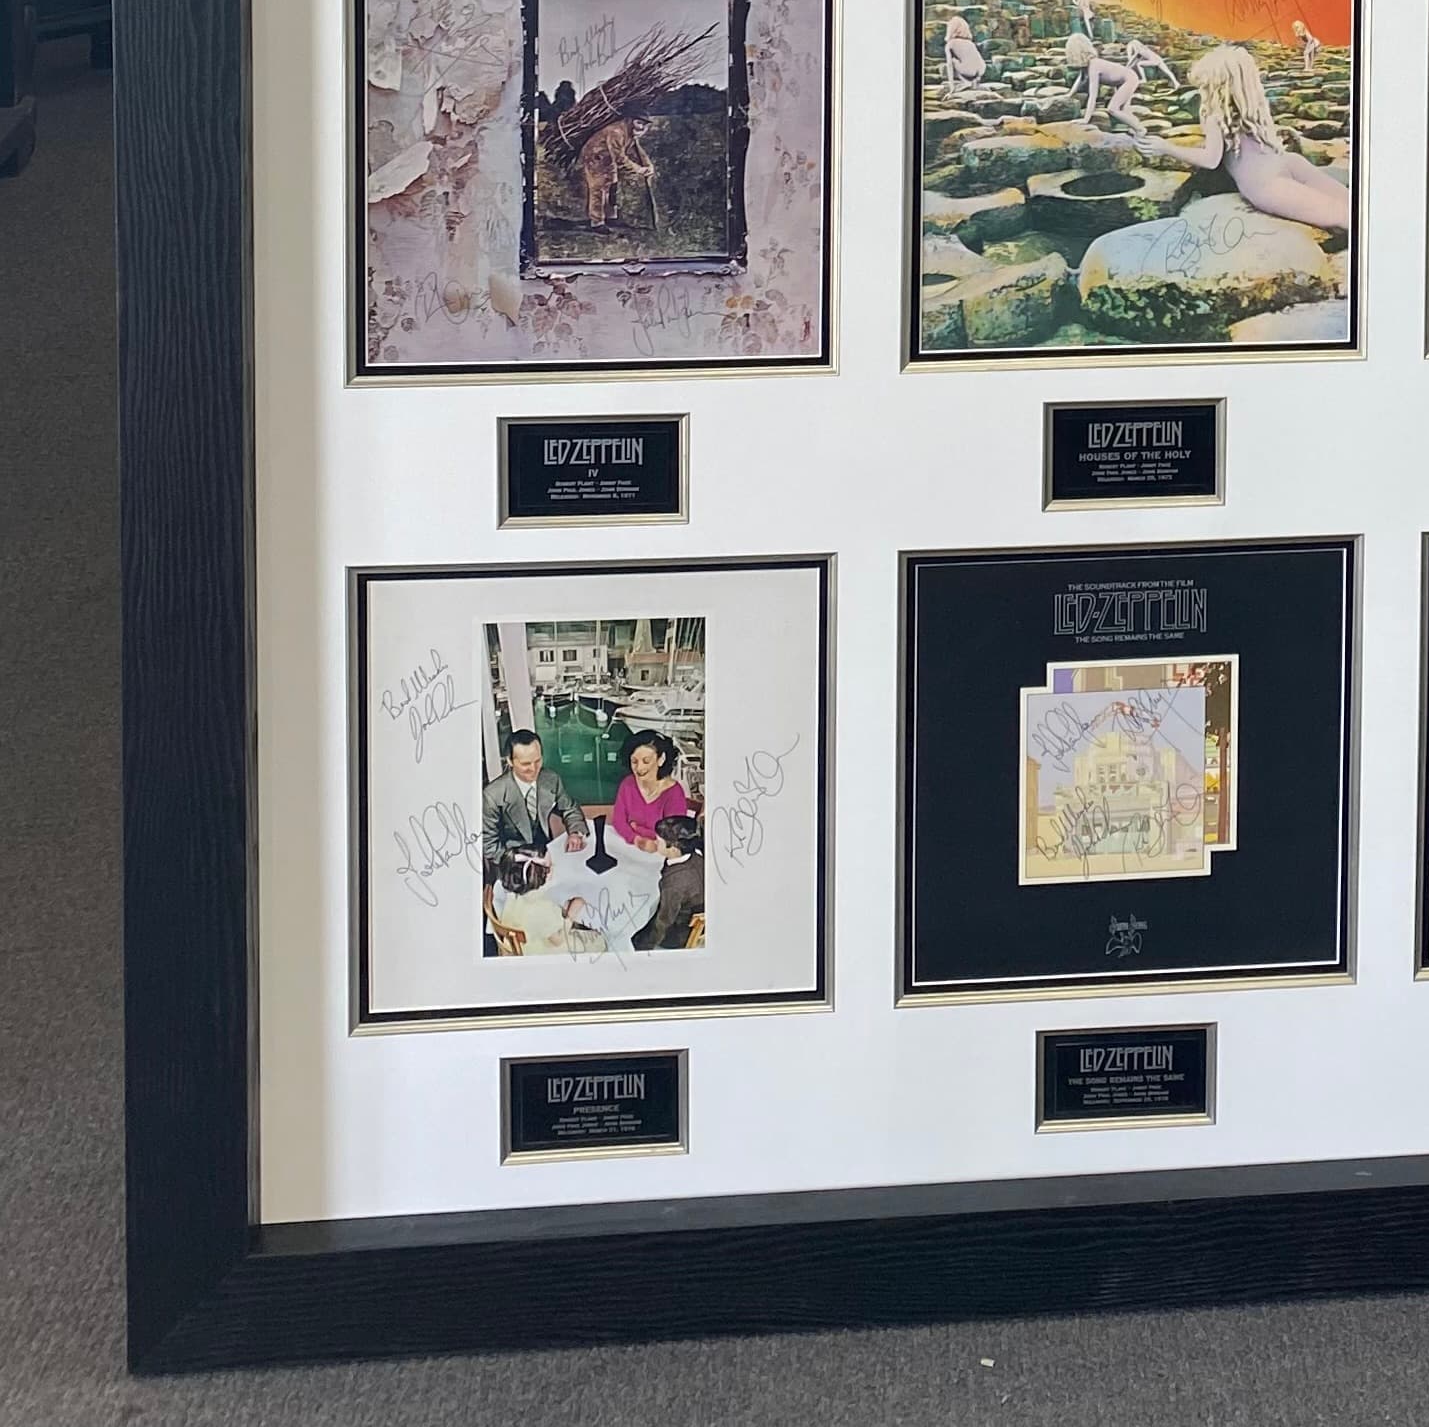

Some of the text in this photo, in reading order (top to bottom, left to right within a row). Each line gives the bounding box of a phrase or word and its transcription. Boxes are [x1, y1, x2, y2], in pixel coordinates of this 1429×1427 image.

[1088, 421, 1183, 448] LED ZEPPELIN
[544, 438, 643, 465] LED ZEPPELIN
[1079, 450, 1192, 461] HOUSES OF THE HOLY
[588, 469, 599, 477] IV
[1080, 1045, 1173, 1073] LED ZEPPELIN
[548, 1074, 645, 1103] LED ZEPPELIN
